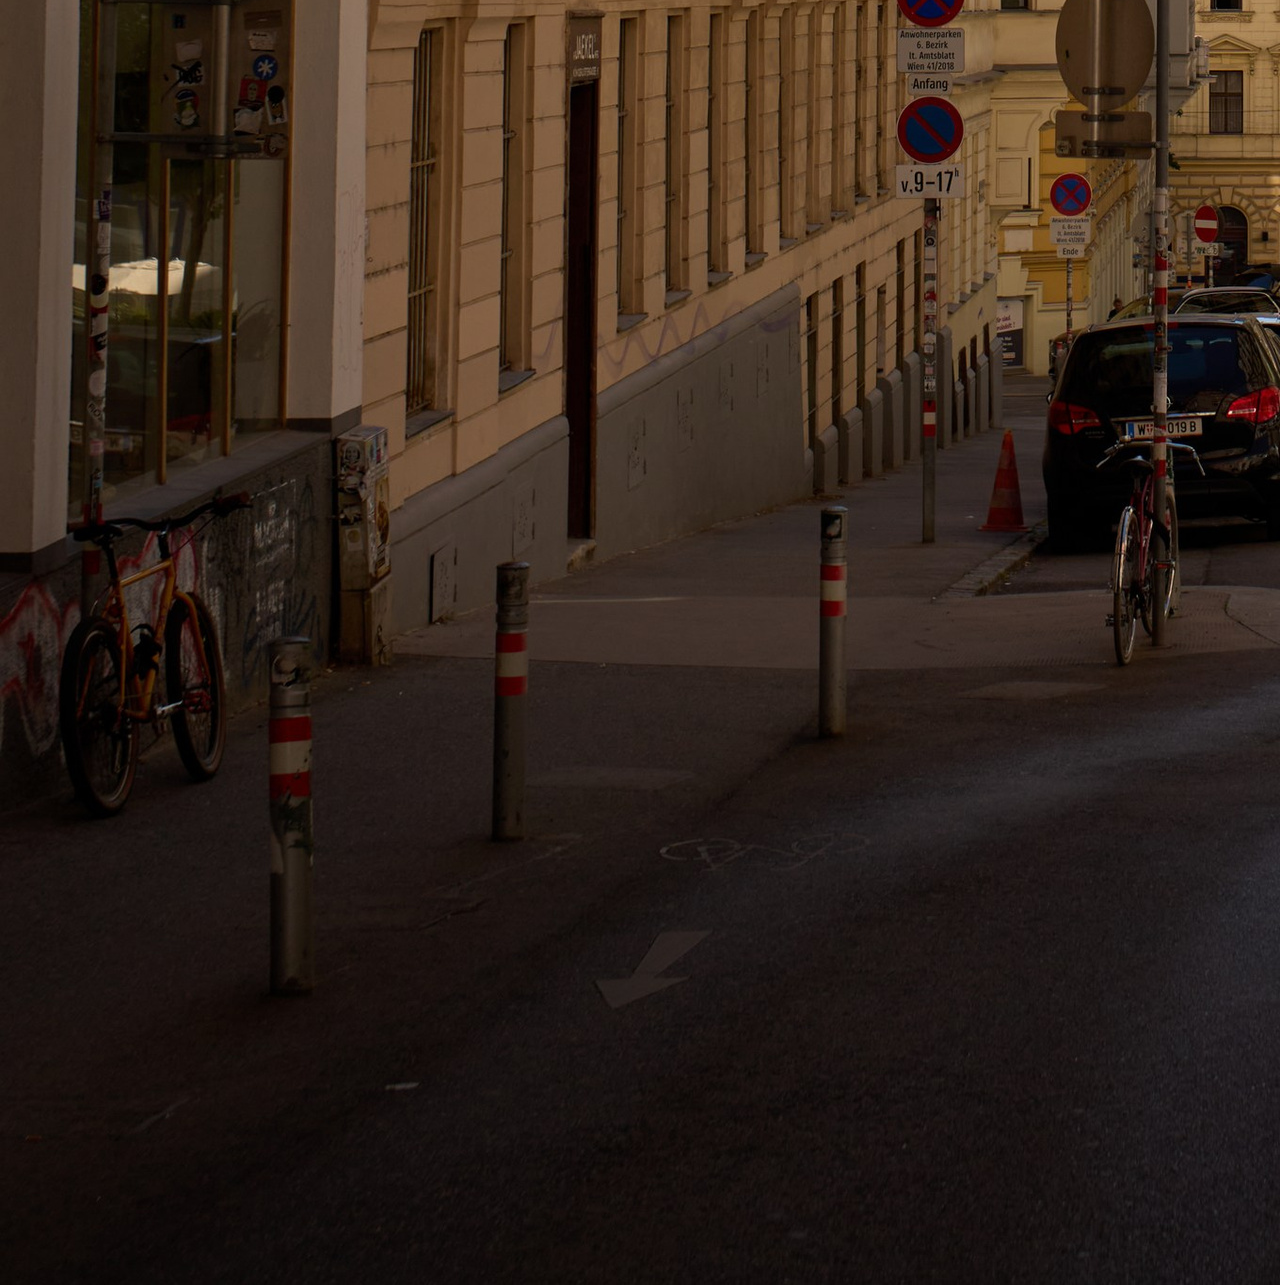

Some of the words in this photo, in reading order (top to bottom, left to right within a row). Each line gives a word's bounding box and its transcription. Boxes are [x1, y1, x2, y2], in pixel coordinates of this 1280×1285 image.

[900, 30, 962, 40] Anwohnerparken
[916, 40, 924, 49] 6.
[925, 40, 949, 49] Bezirk
[919, 51, 956, 60] Amtsblatt
[907, 61, 925, 71] Wien
[926, 61, 955, 71] 41/2018
[912, 77, 949, 92] Anfang
[1062, 247, 1079, 256] Ende
[1137, 423, 1146, 436] W
[1190, 419, 1197, 432] B
